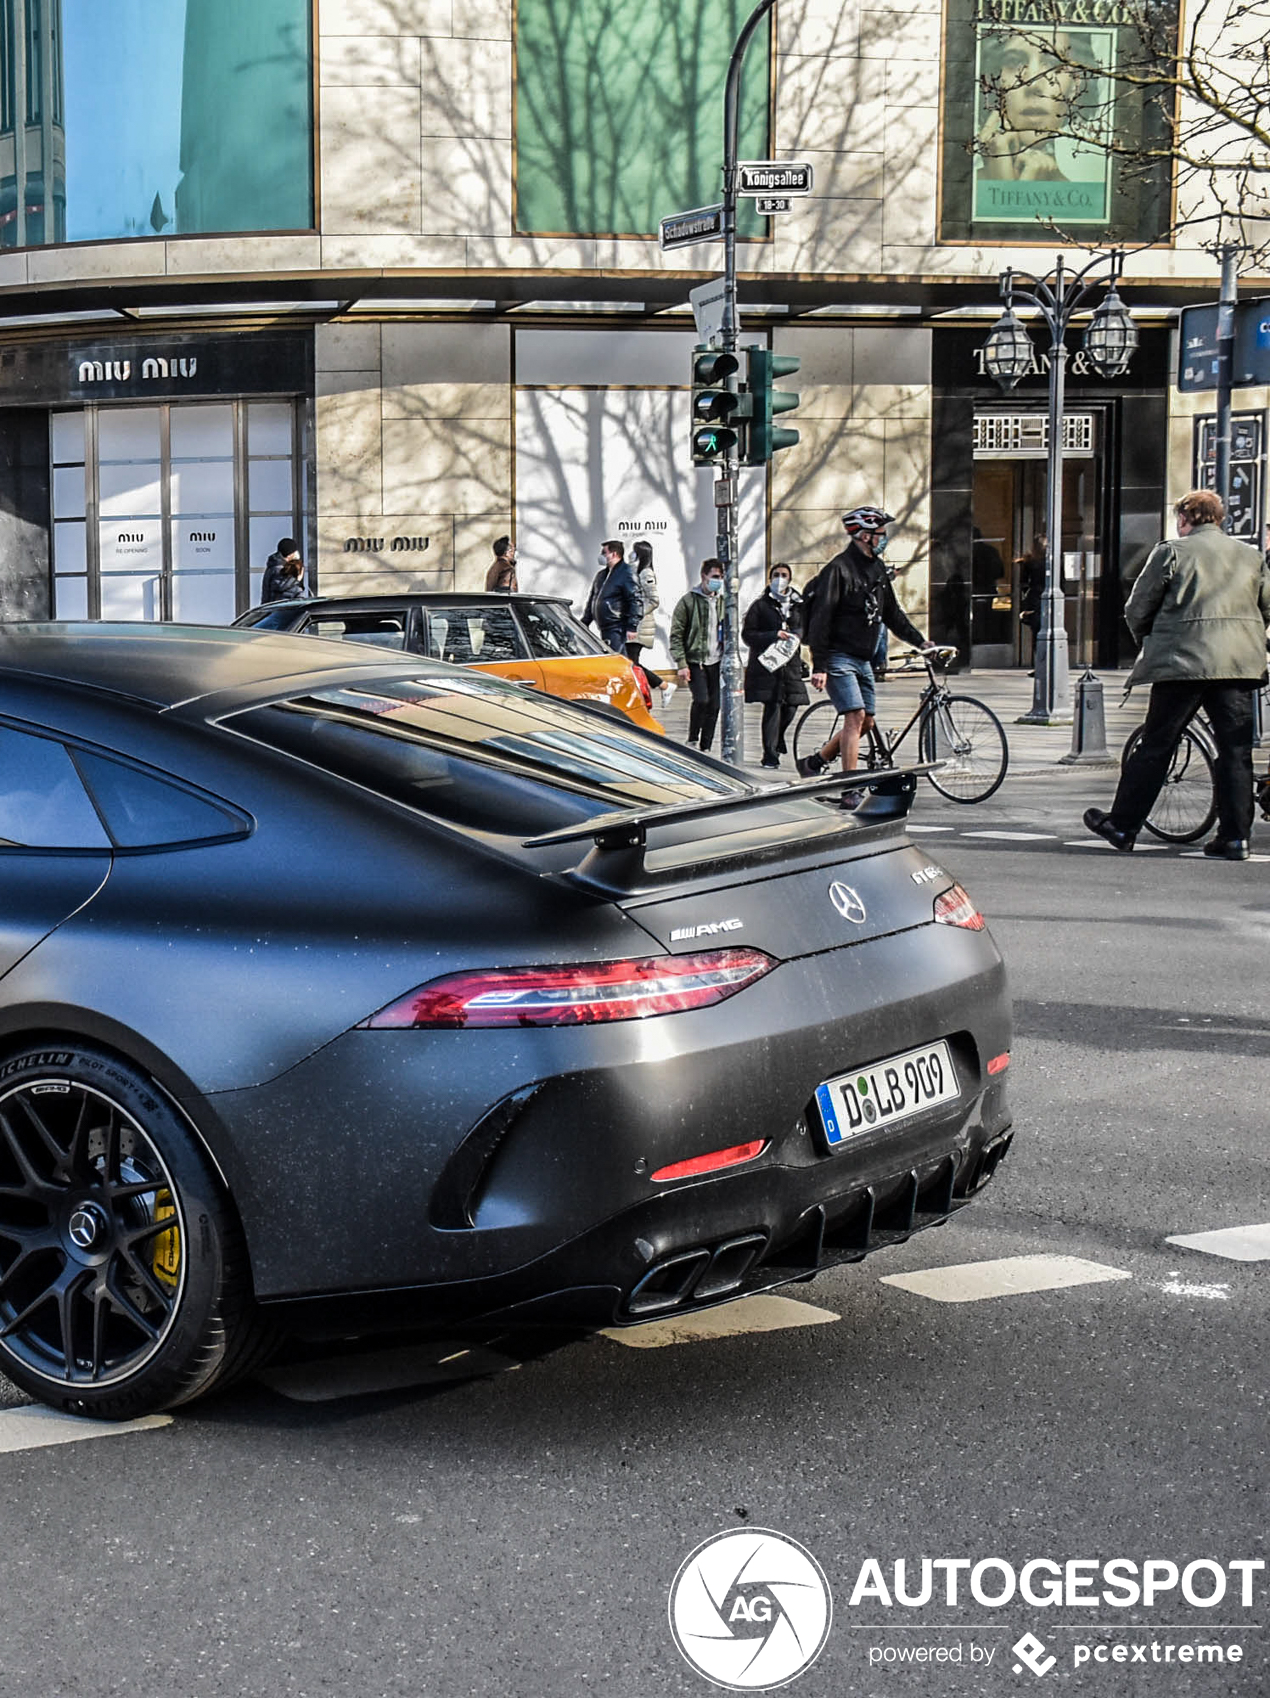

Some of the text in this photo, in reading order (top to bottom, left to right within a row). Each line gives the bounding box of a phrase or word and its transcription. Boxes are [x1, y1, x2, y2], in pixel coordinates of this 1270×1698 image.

[746, 171, 804, 188] Königsallee
[763, 200, 786, 209] 18-30
[665, 214, 715, 240] Schadowstraße
[696, 918, 744, 937] AMG
[840, 1083, 862, 1129] D
[870, 1067, 906, 1117] LB
[904, 1053, 943, 1104] 909
[827, 1119, 835, 1132] D
